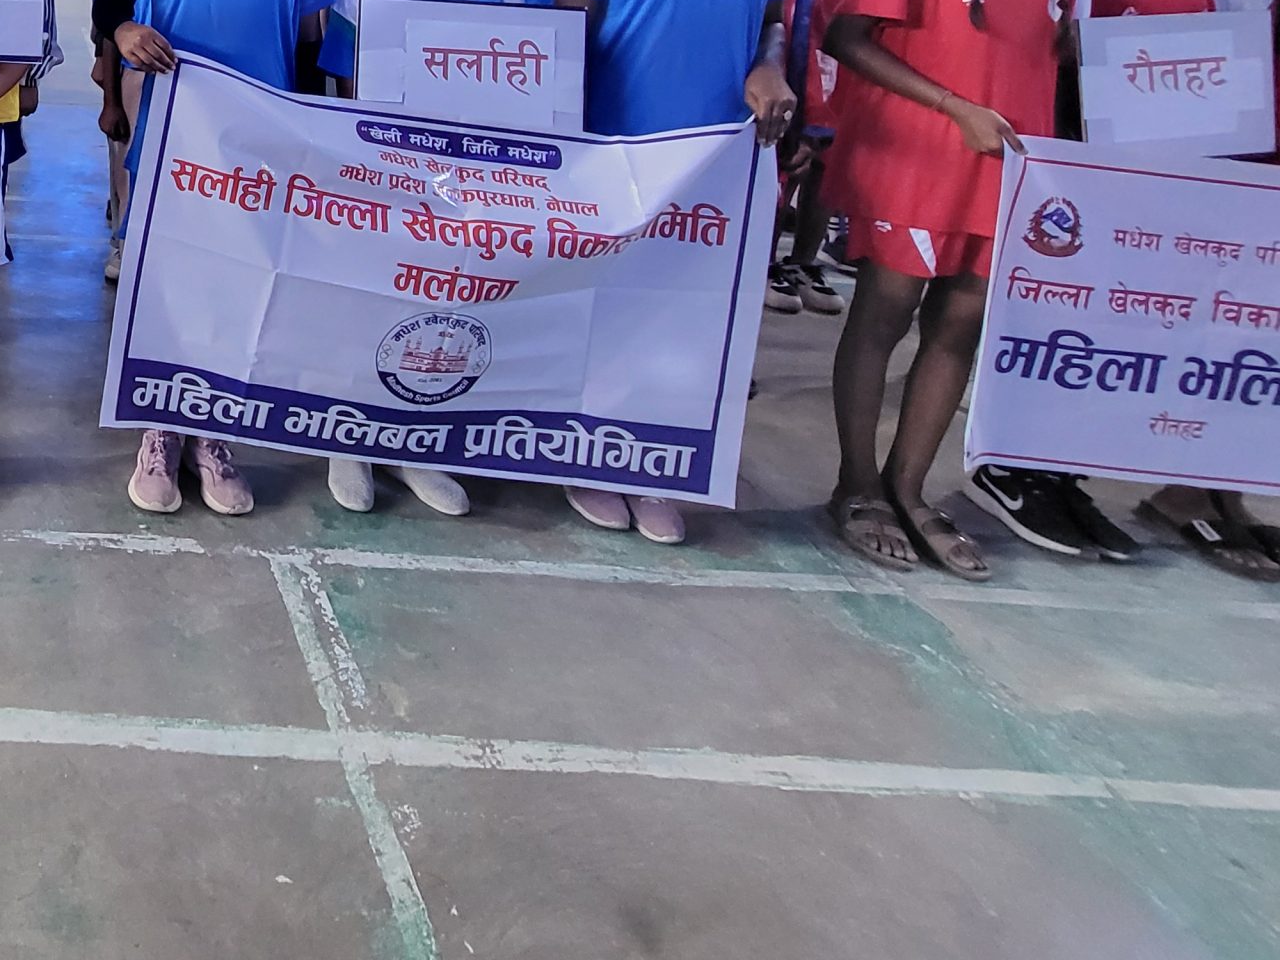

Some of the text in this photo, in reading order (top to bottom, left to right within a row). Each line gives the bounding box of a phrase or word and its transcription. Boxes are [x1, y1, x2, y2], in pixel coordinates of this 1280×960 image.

[422, 37, 549, 96] सर्लाही
[1122, 49, 1227, 100] रौतहट
[462, 137, 501, 158] जिति
[170, 158, 277, 212] सर्लाही
[283, 173, 392, 233] जिल्ला
[401, 202, 536, 261] खेलकुद
[339, 163, 384, 186] मधेश
[544, 196, 600, 217] नेपाल
[1113, 226, 1163, 252] मधेश
[1174, 232, 1245, 268] खेलकुद
[394, 263, 519, 304] मलंगवा
[1007, 266, 1095, 310] जिल्ला
[1108, 281, 1198, 329] खेलकुद
[994, 329, 1168, 394] महिला
[132, 372, 697, 479] महिला भलिबल प्रतियोगिता
[1149, 411, 1208, 440] रौतहट
